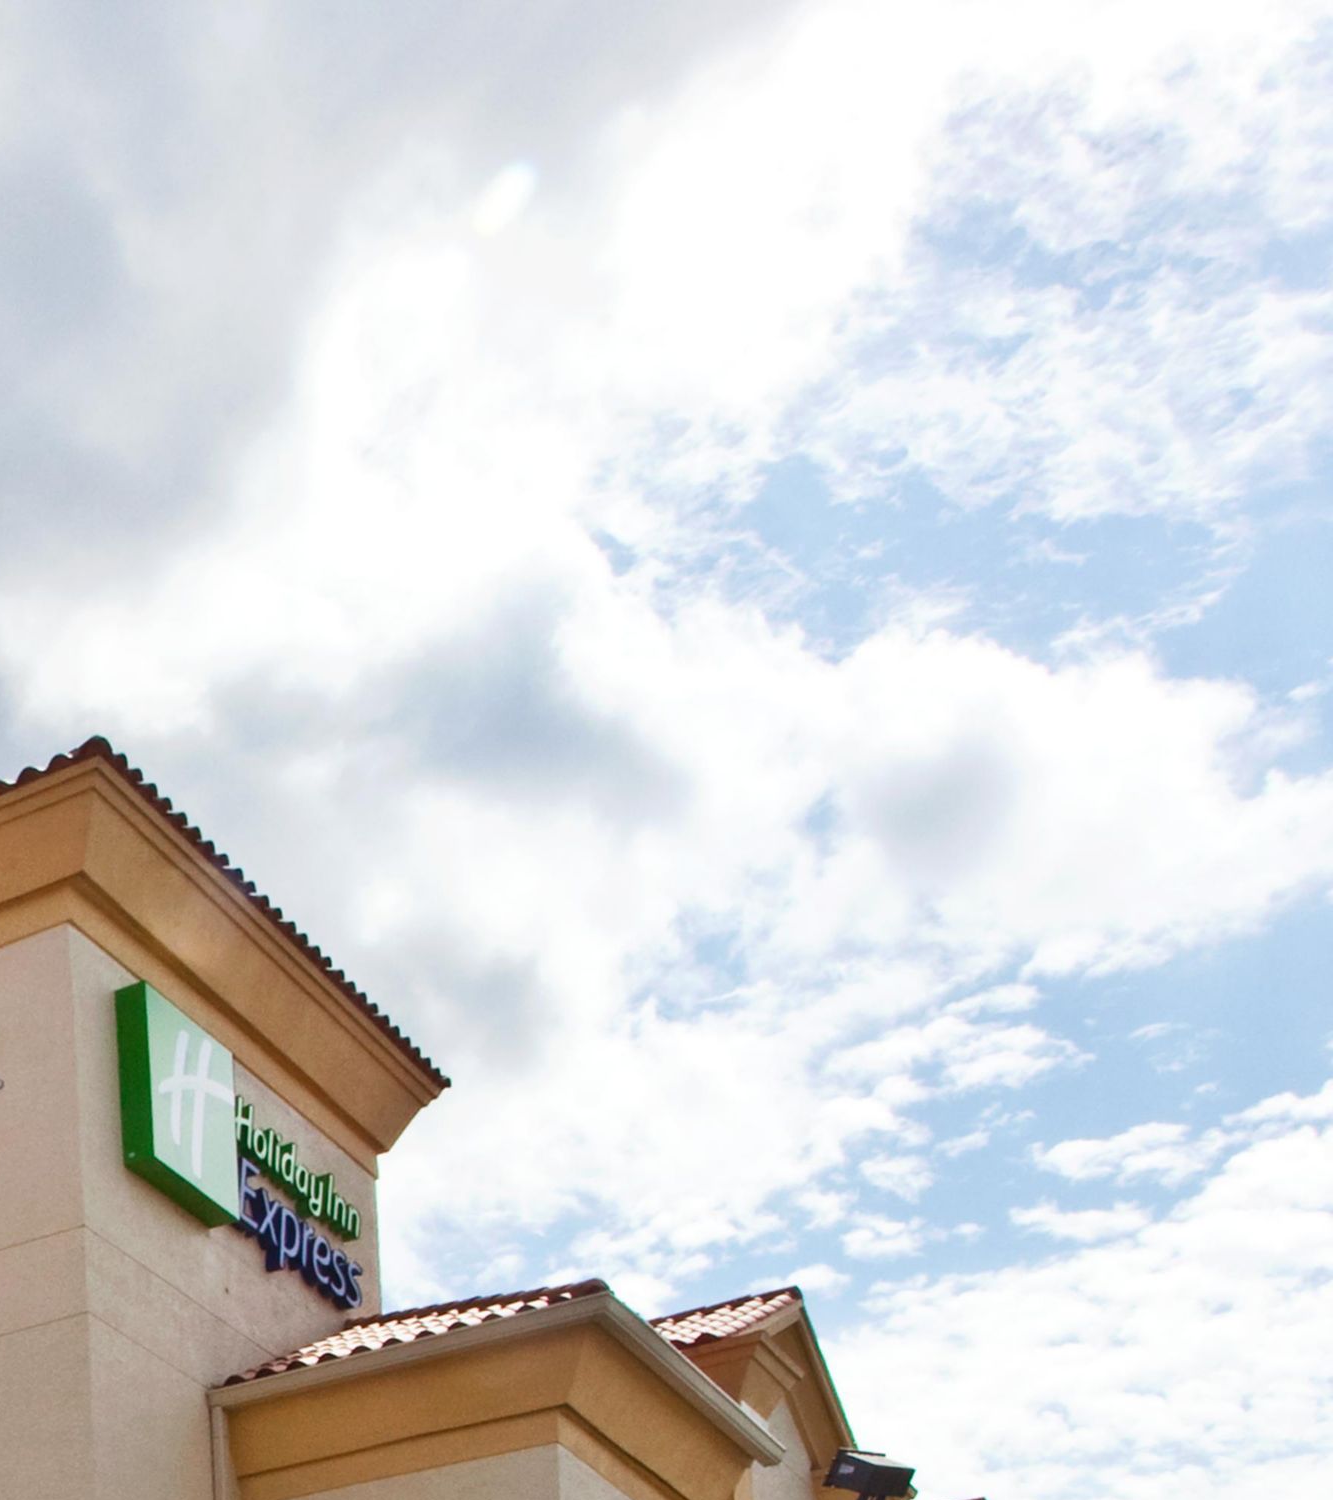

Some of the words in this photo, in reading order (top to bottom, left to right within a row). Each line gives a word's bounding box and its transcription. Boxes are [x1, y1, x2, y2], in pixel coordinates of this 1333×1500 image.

[235, 1095, 327, 1218] Holiday
[325, 1173, 362, 1242] Inn
[237, 1155, 363, 1310] Express
